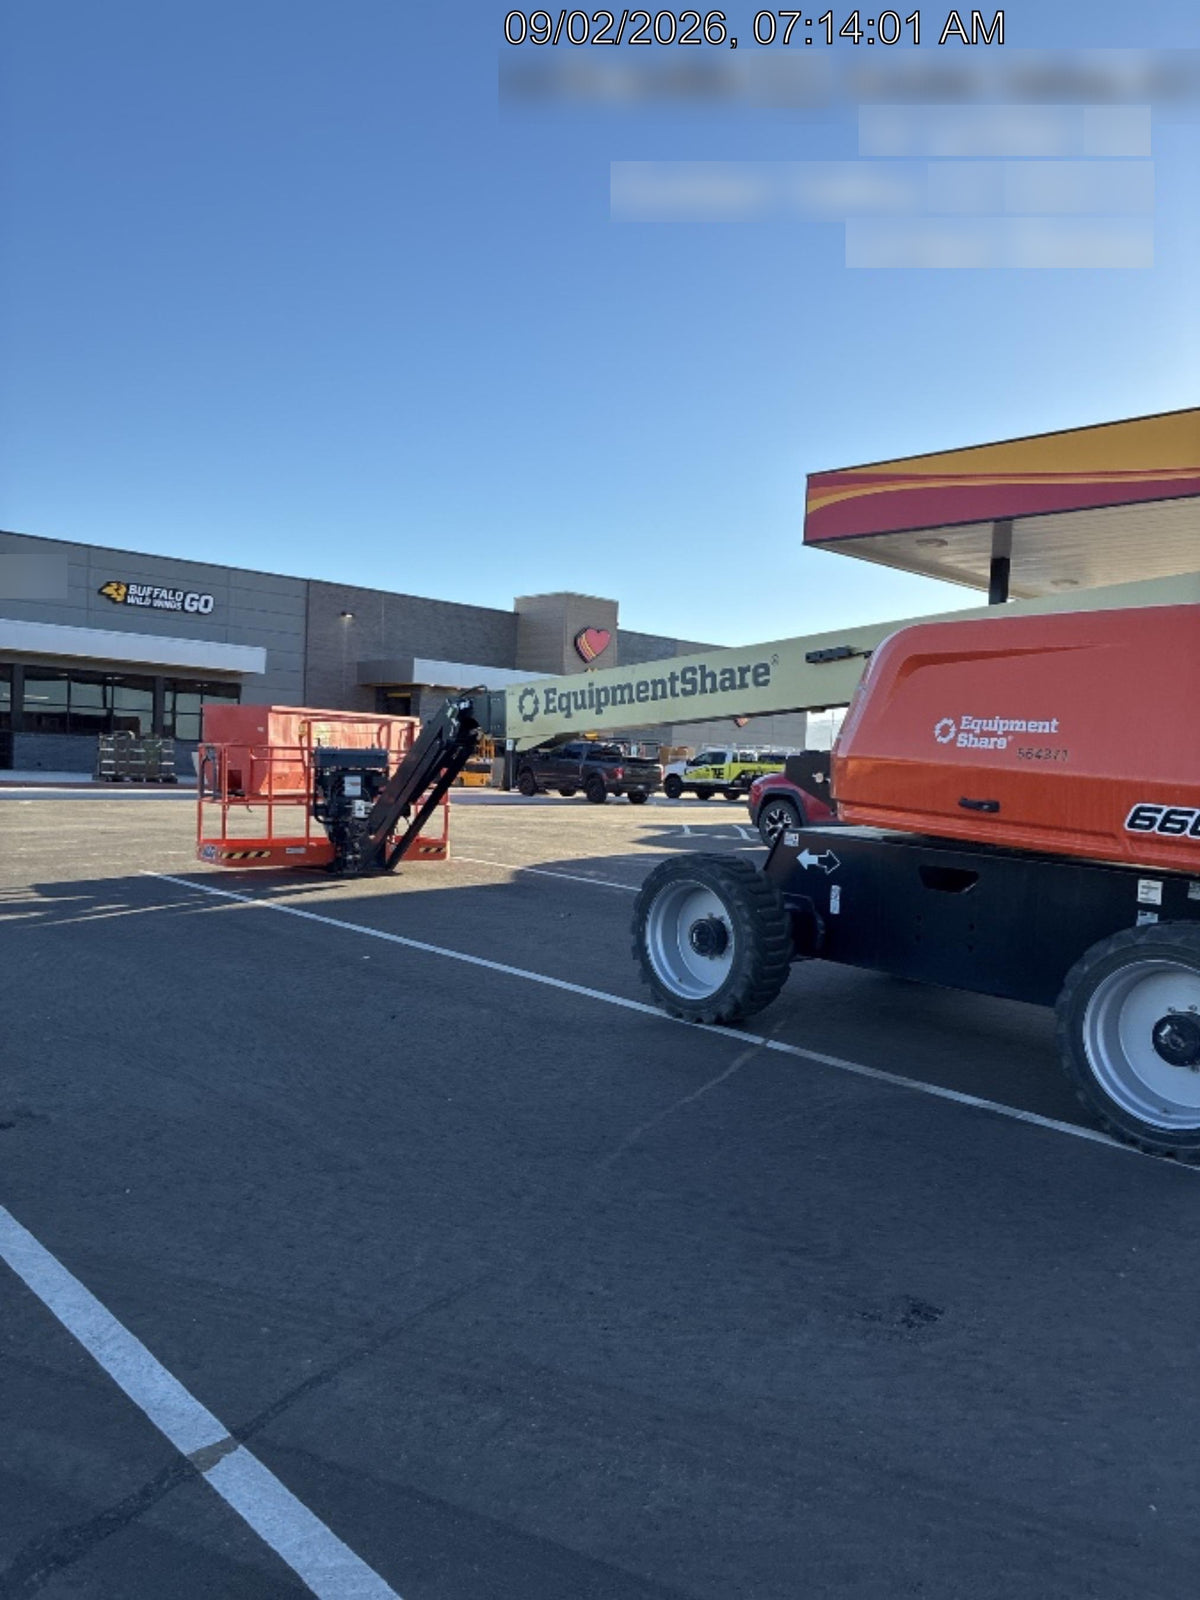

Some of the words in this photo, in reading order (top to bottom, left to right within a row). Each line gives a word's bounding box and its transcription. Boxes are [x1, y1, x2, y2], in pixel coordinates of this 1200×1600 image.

[128, 584, 183, 601] BUFFALO
[184, 593, 214, 614] GO
[959, 715, 1060, 735] Equipment
